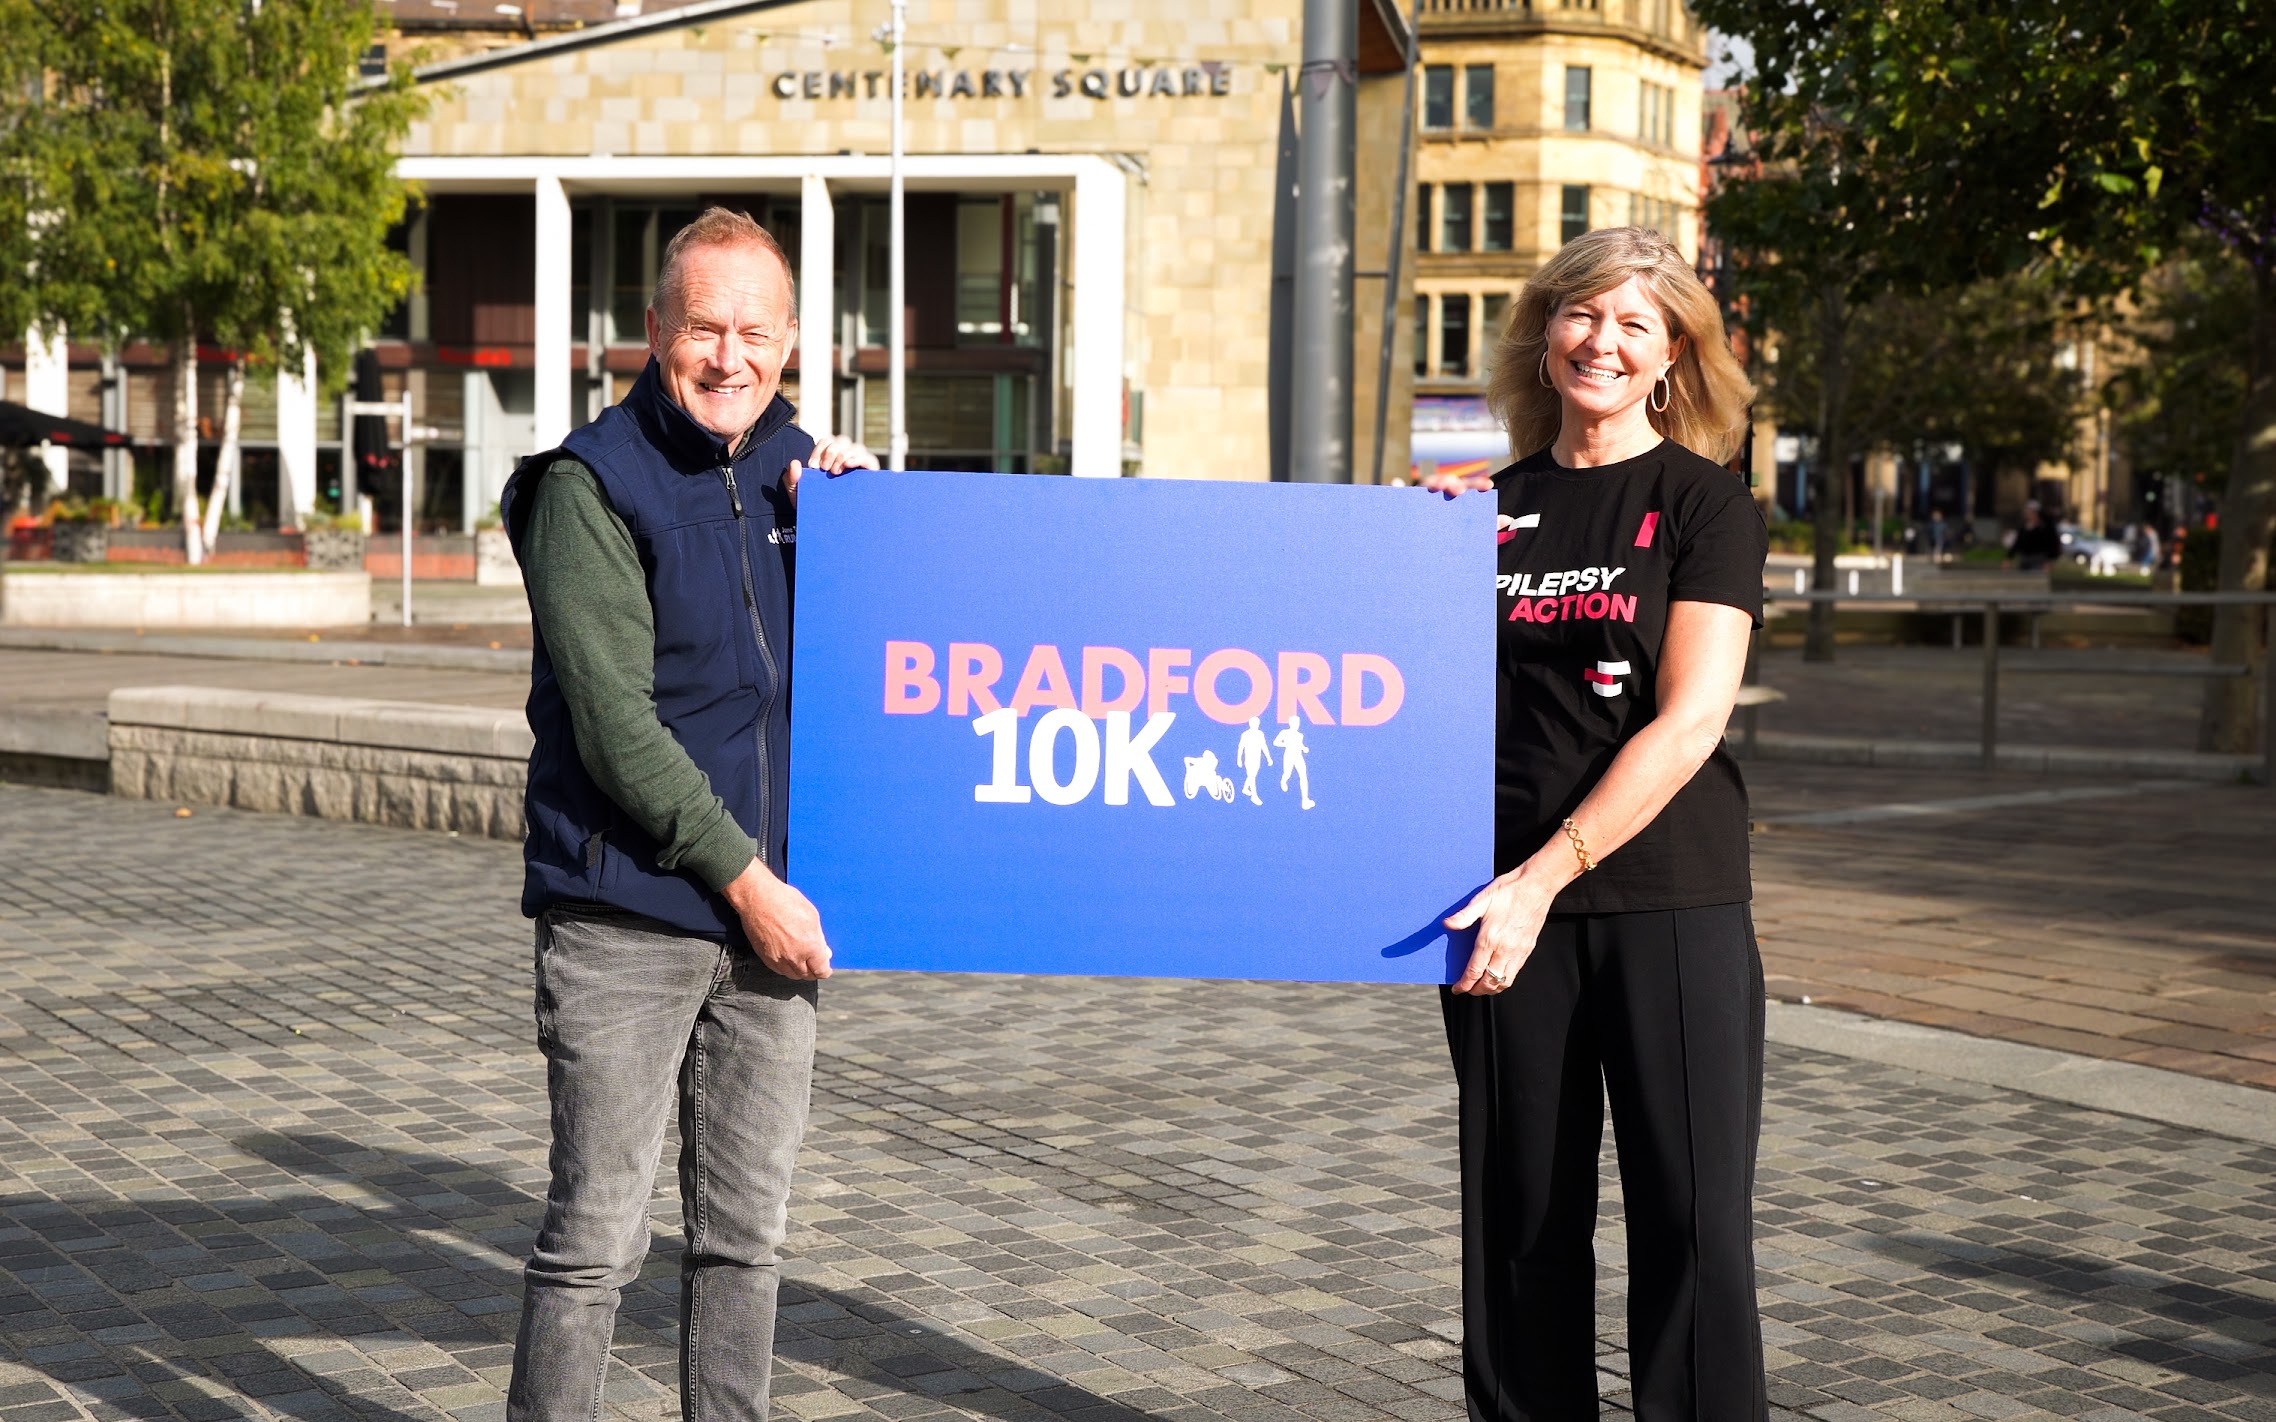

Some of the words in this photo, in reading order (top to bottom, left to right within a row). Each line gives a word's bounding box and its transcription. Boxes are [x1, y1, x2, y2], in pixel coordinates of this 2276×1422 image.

[1053, 68, 1231, 99] SQUARE
[1497, 567, 1626, 596] PILEPSY
[1508, 592, 1638, 623] ACTION
[883, 640, 1405, 726] BRADFORD
[972, 707, 1177, 807] 10K
